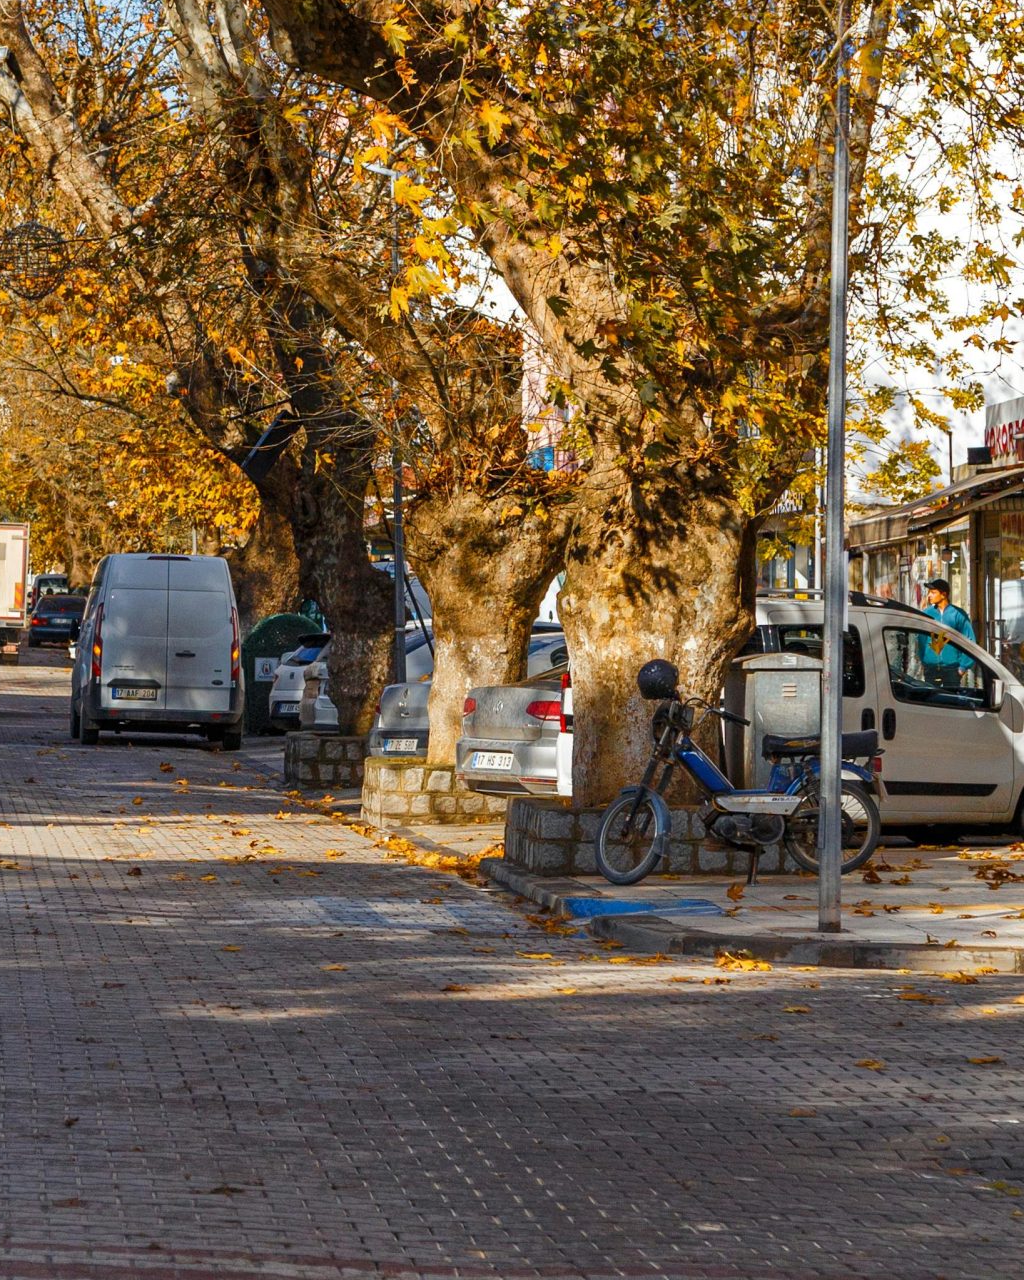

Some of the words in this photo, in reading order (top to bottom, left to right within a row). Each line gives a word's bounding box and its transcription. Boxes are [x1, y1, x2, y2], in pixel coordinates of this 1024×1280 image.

[116, 689, 124, 697] 17
[142, 690, 155, 698] 204
[478, 754, 485, 765] 17
[486, 755, 496, 766] HS
[498, 756, 512, 767] 313
